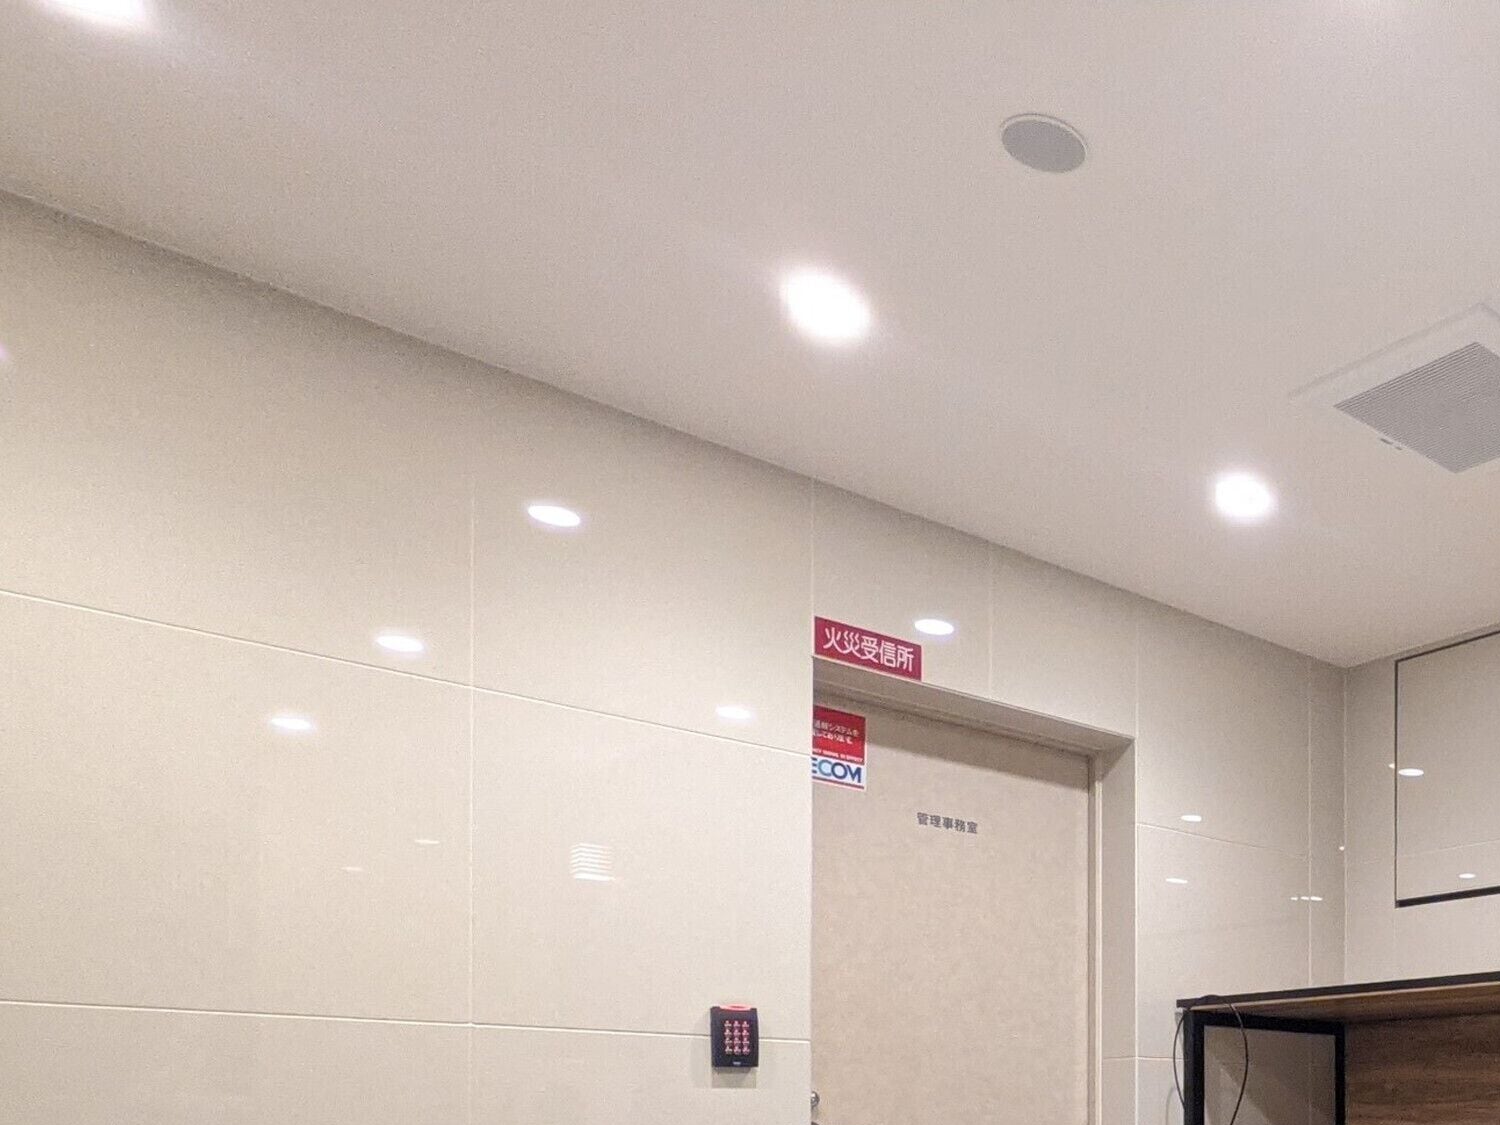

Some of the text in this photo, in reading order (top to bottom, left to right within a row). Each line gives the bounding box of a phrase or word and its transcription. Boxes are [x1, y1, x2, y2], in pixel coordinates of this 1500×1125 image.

[822, 626, 914, 673] 火災受信所
[916, 811, 978, 834] 管理事務室
